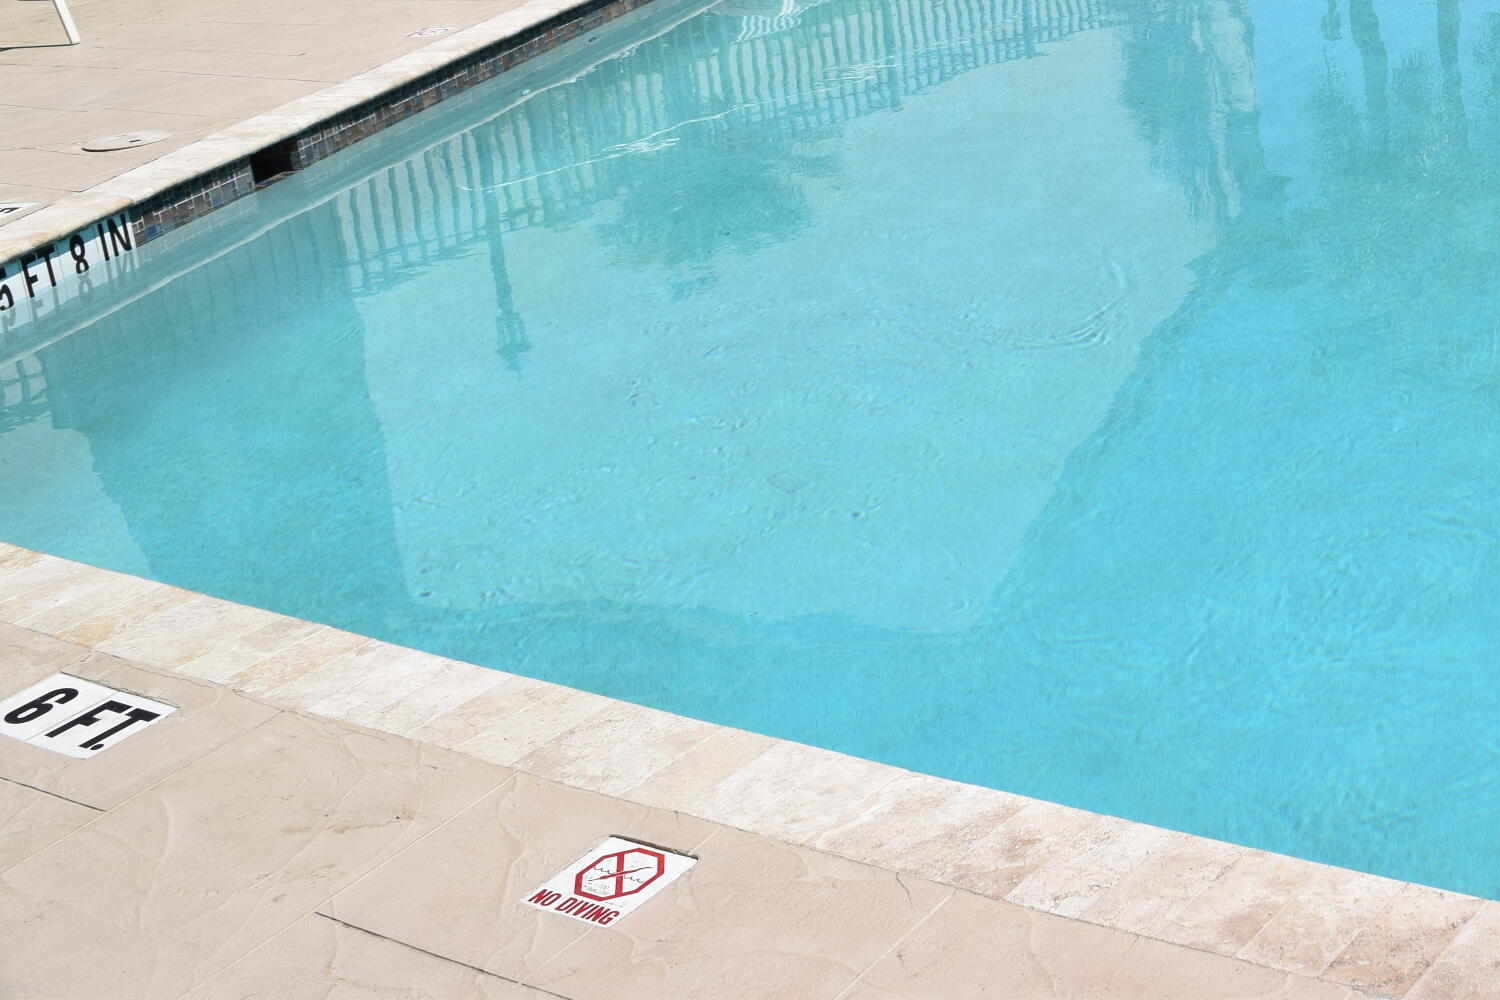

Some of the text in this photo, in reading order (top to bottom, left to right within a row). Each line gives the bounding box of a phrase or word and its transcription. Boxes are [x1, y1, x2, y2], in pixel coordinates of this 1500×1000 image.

[19, 244, 57, 298] FT
[69, 234, 90, 274] 8
[97, 213, 132, 261] IN
[4, 687, 162, 751] 6 FT.
[527, 888, 620, 925] NO DIVING
